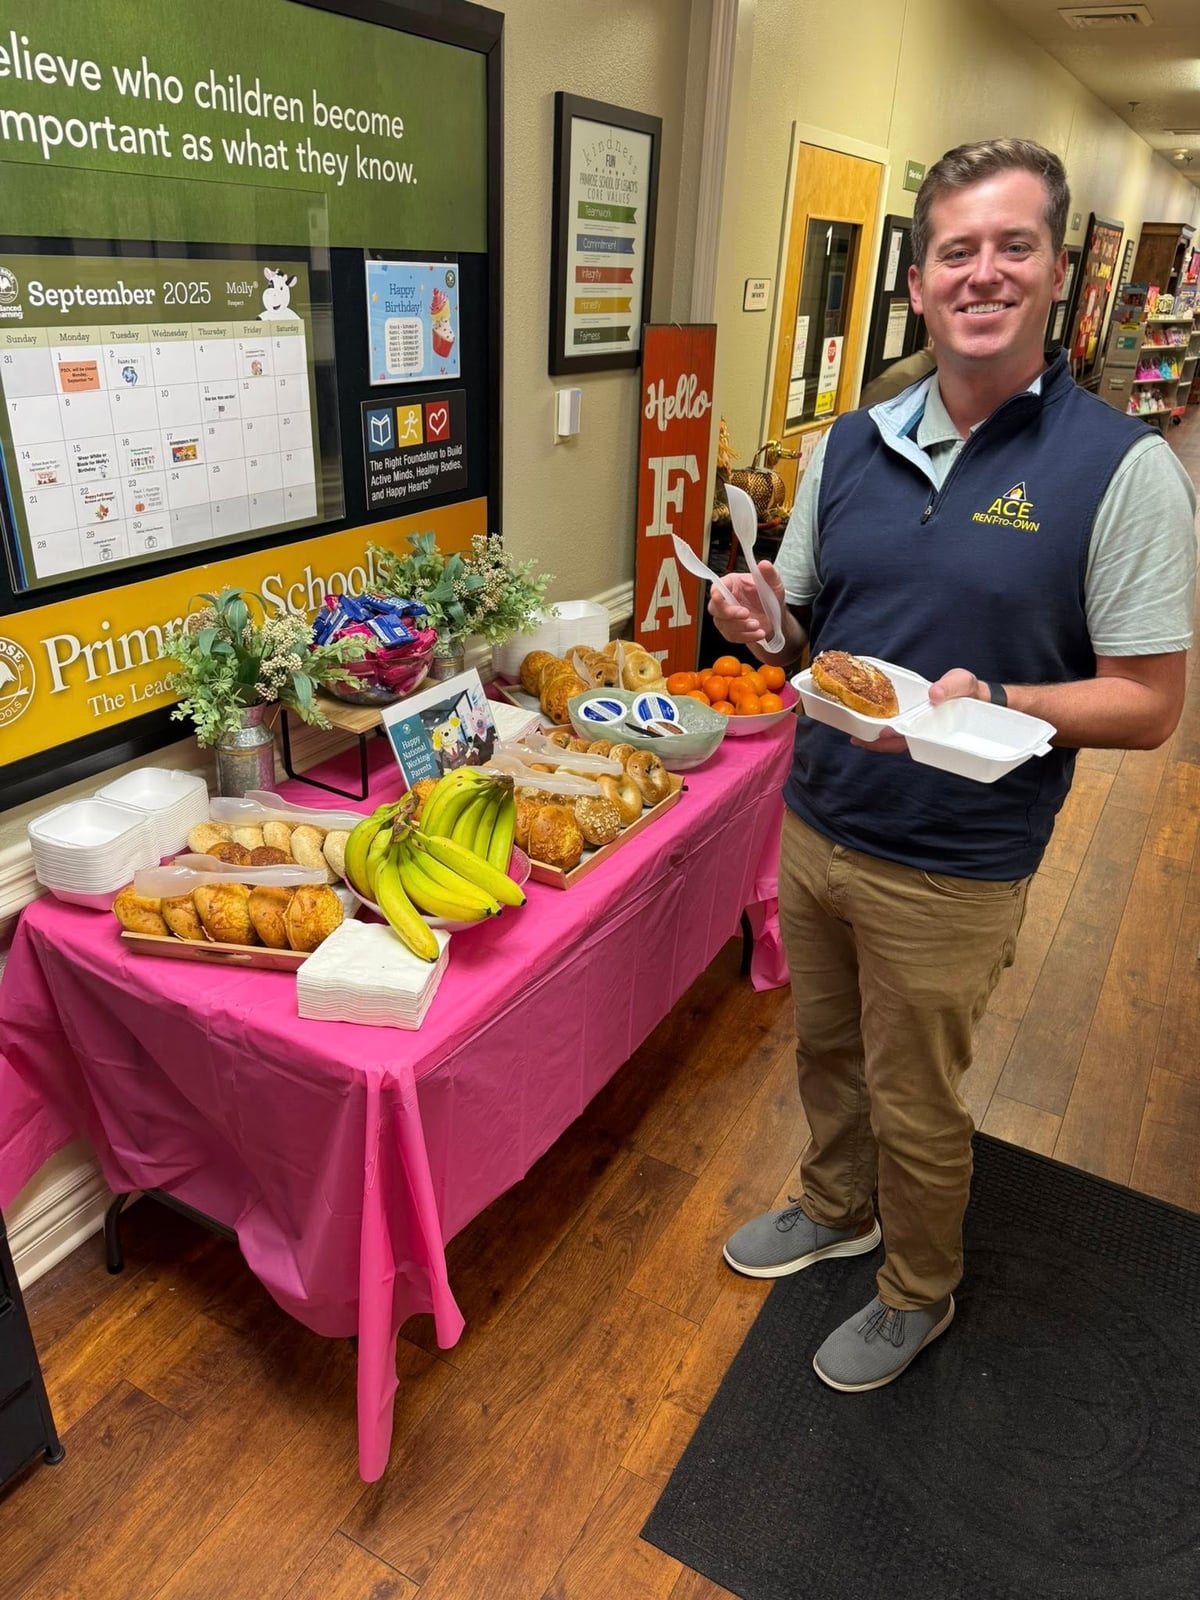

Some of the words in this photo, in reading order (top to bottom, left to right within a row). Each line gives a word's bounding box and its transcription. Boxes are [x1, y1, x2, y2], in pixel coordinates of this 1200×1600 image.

[111, 56, 183, 104] who
[194, 69, 305, 124] children
[312, 89, 404, 139] become
[182, 133, 213, 162] as
[222, 129, 290, 171] what
[296, 138, 349, 186] they
[356, 145, 418, 184] know.
[605, 153, 616, 168] FUN
[587, 187, 603, 201] CORE
[607, 190, 630, 205] VALUES
[583, 238, 617, 250] Commitment
[826, 225, 833, 256] 1
[28, 280, 155, 313] September
[163, 282, 211, 304] 2025
[389, 283, 416, 299] Happy
[384, 301, 422, 316] Birthday!
[6, 334, 37, 345] Sunday
[59, 333, 90, 343] Monday
[110, 331, 139, 340] Tuesday
[152, 328, 188, 338] Wednesday
[198, 327, 226, 337] Thursday
[243, 326, 262, 335] Friday
[276, 325, 299, 333] Saturday
[4, 355, 13, 364] 31
[160, 390, 169, 398] 10
[645, 373, 712, 432] Hello
[73, 444, 82, 452] 15
[122, 438, 130, 446] 16
[22, 451, 30, 460] 14
[369, 460, 383, 472] The
[384, 457, 402, 470] Right
[403, 449, 439, 465] Foundation
[440, 449, 446, 458] to
[447, 444, 463, 457] Build
[370, 473, 392, 487] Active
[393, 470, 416, 482] Minds,
[416, 464, 440, 478] Healthy
[440, 460, 463, 473] Bodies,
[80, 488, 90, 496] 22
[128, 480, 137, 488] 23
[29, 496, 38, 504] 21
[371, 490, 385, 502] and
[386, 485, 407, 499] Happy
[987, 498, 1034, 519] ACE
[133, 521, 142, 529] 30
[972, 512, 1040, 533] RENT-TO-OWN
[86, 530, 95, 538] 29
[37, 540, 46, 549] 28
[40, 612, 201, 694] Primr
[88, 693, 125, 717] The
[129, 676, 176, 703] Lead
[401, 735, 421, 750] Happy
[402, 744, 427, 761] National
[405, 753, 431, 770] Working
[410, 763, 433, 779] Parents
